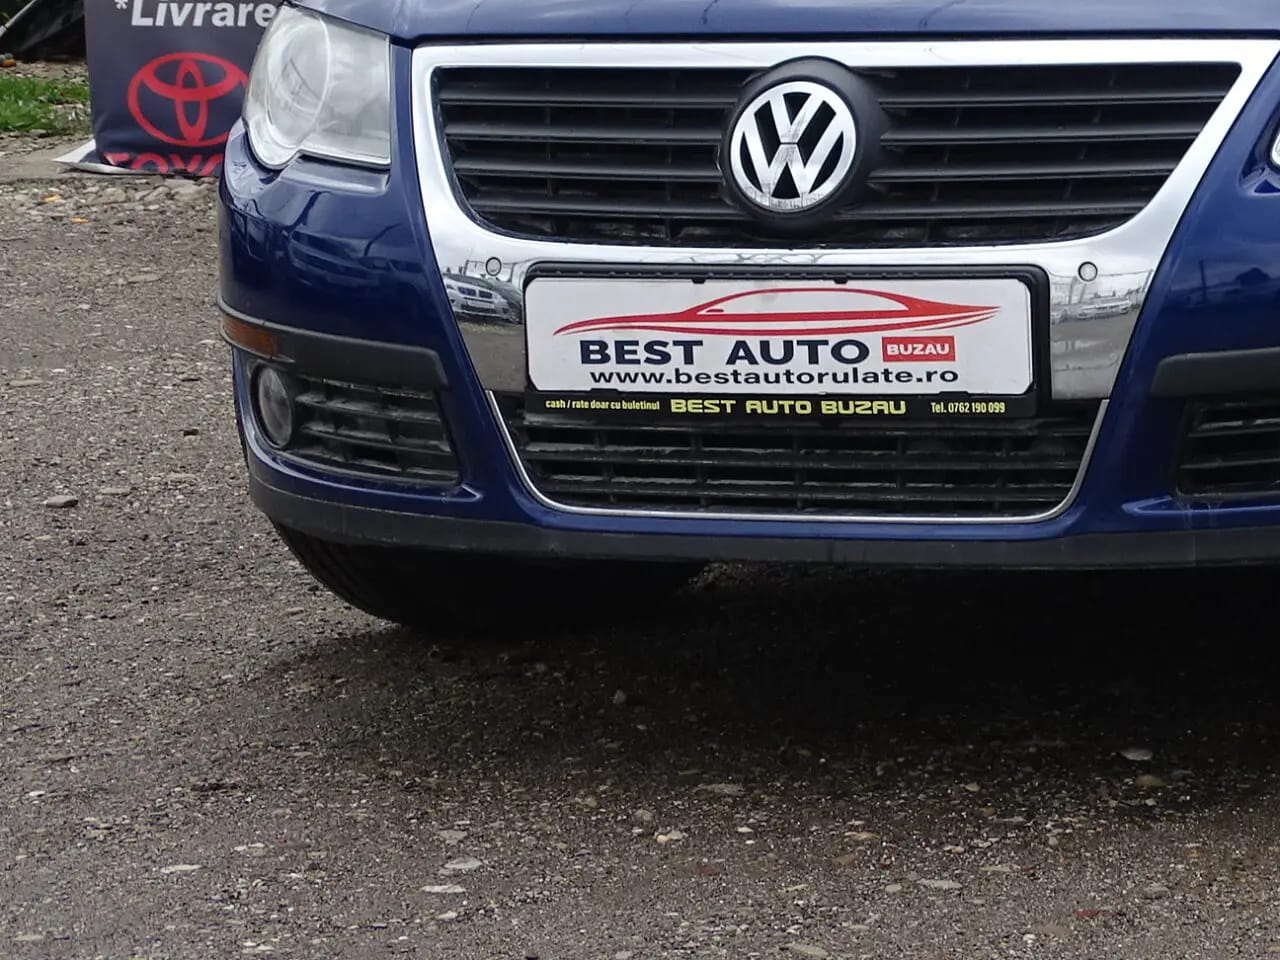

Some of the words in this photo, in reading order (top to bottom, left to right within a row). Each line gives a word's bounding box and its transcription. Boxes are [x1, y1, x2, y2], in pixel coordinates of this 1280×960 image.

[579, 339, 704, 366] BEST
[725, 339, 870, 366] AUTO
[886, 343, 950, 356] BUZAU
[589, 367, 959, 385] www.bestautorulate.ro
[545, 399, 566, 409] cash
[572, 400, 590, 409] rate
[670, 398, 737, 414] BEST
[745, 399, 813, 415] AUTO
[820, 400, 907, 415] BUZAU
[930, 401, 947, 413] Tel.
[948, 401, 970, 414] 0762
[971, 401, 987, 414] 190
